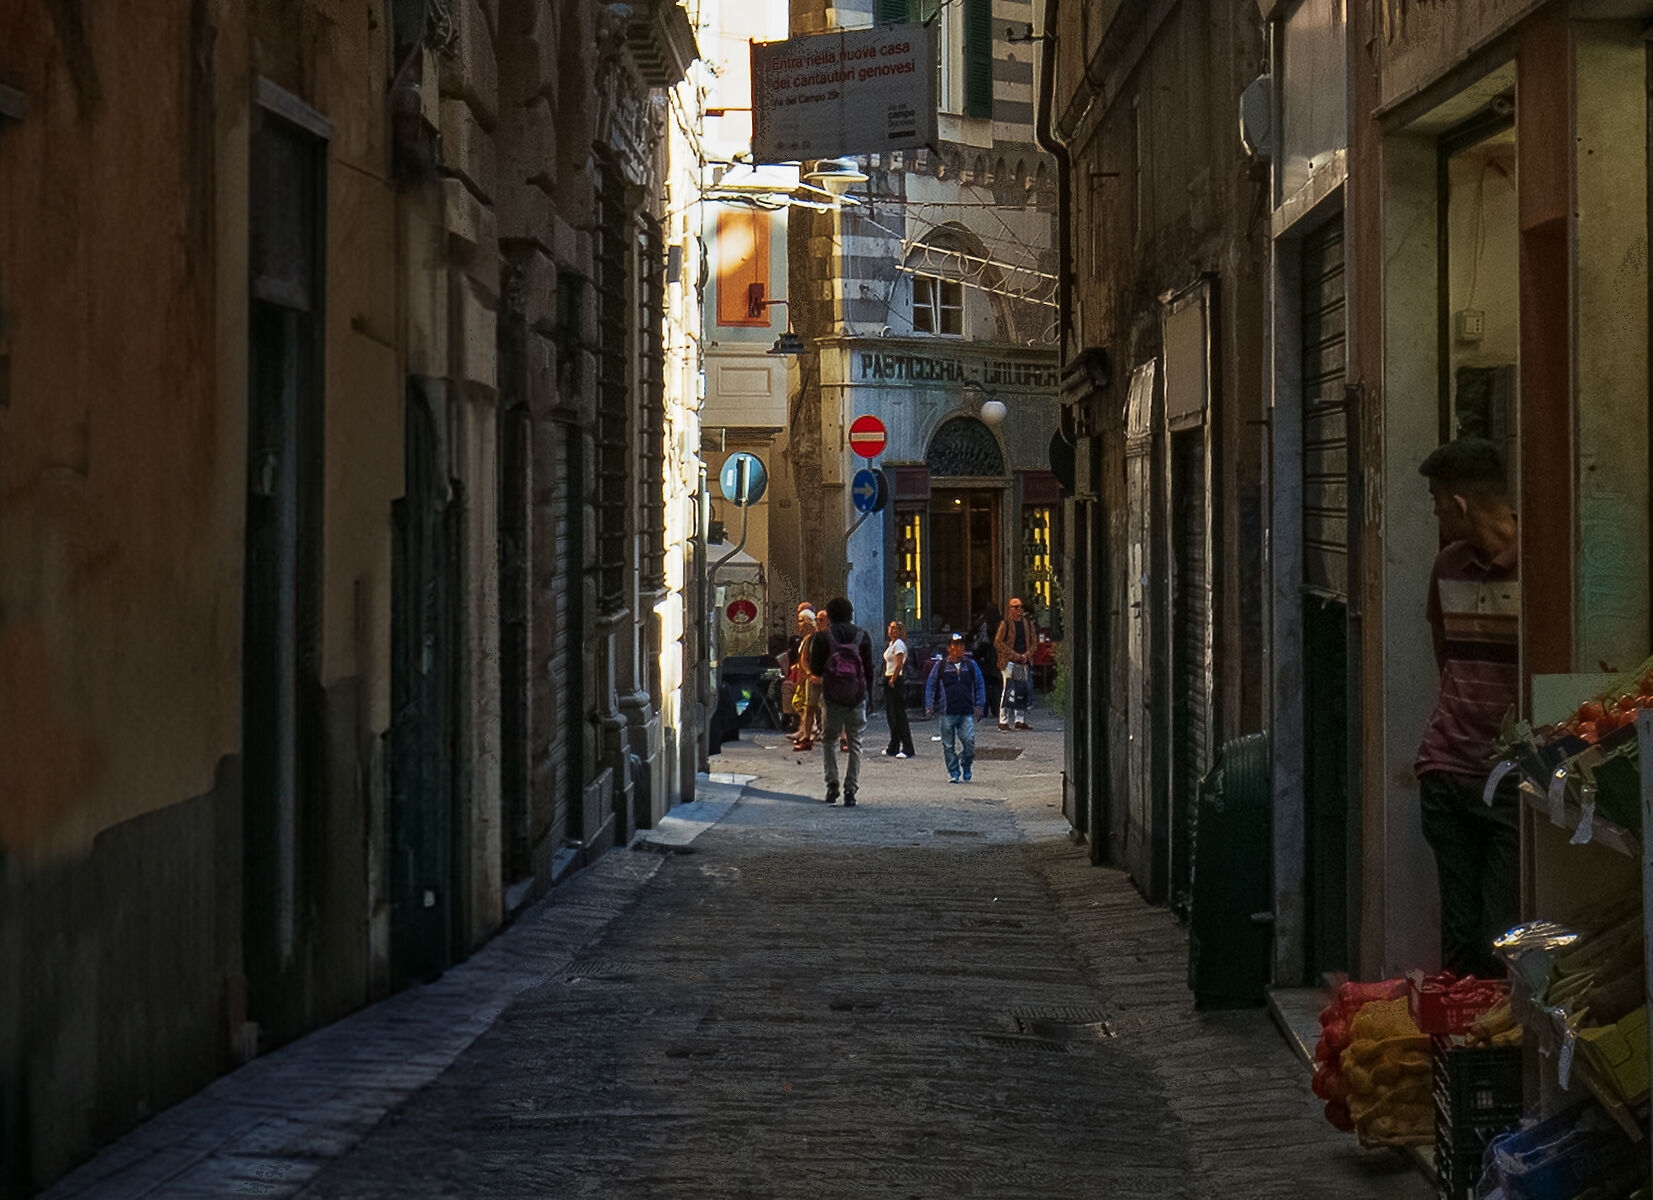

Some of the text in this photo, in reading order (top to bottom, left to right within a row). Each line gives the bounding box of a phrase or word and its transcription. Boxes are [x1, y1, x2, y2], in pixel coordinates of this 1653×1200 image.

[772, 41, 910, 71] Entra nella nuova casa
[772, 59, 915, 91] dei cantautori genovesi
[798, 91, 825, 105] Campo
[861, 352, 965, 382] PASTICCERIA
